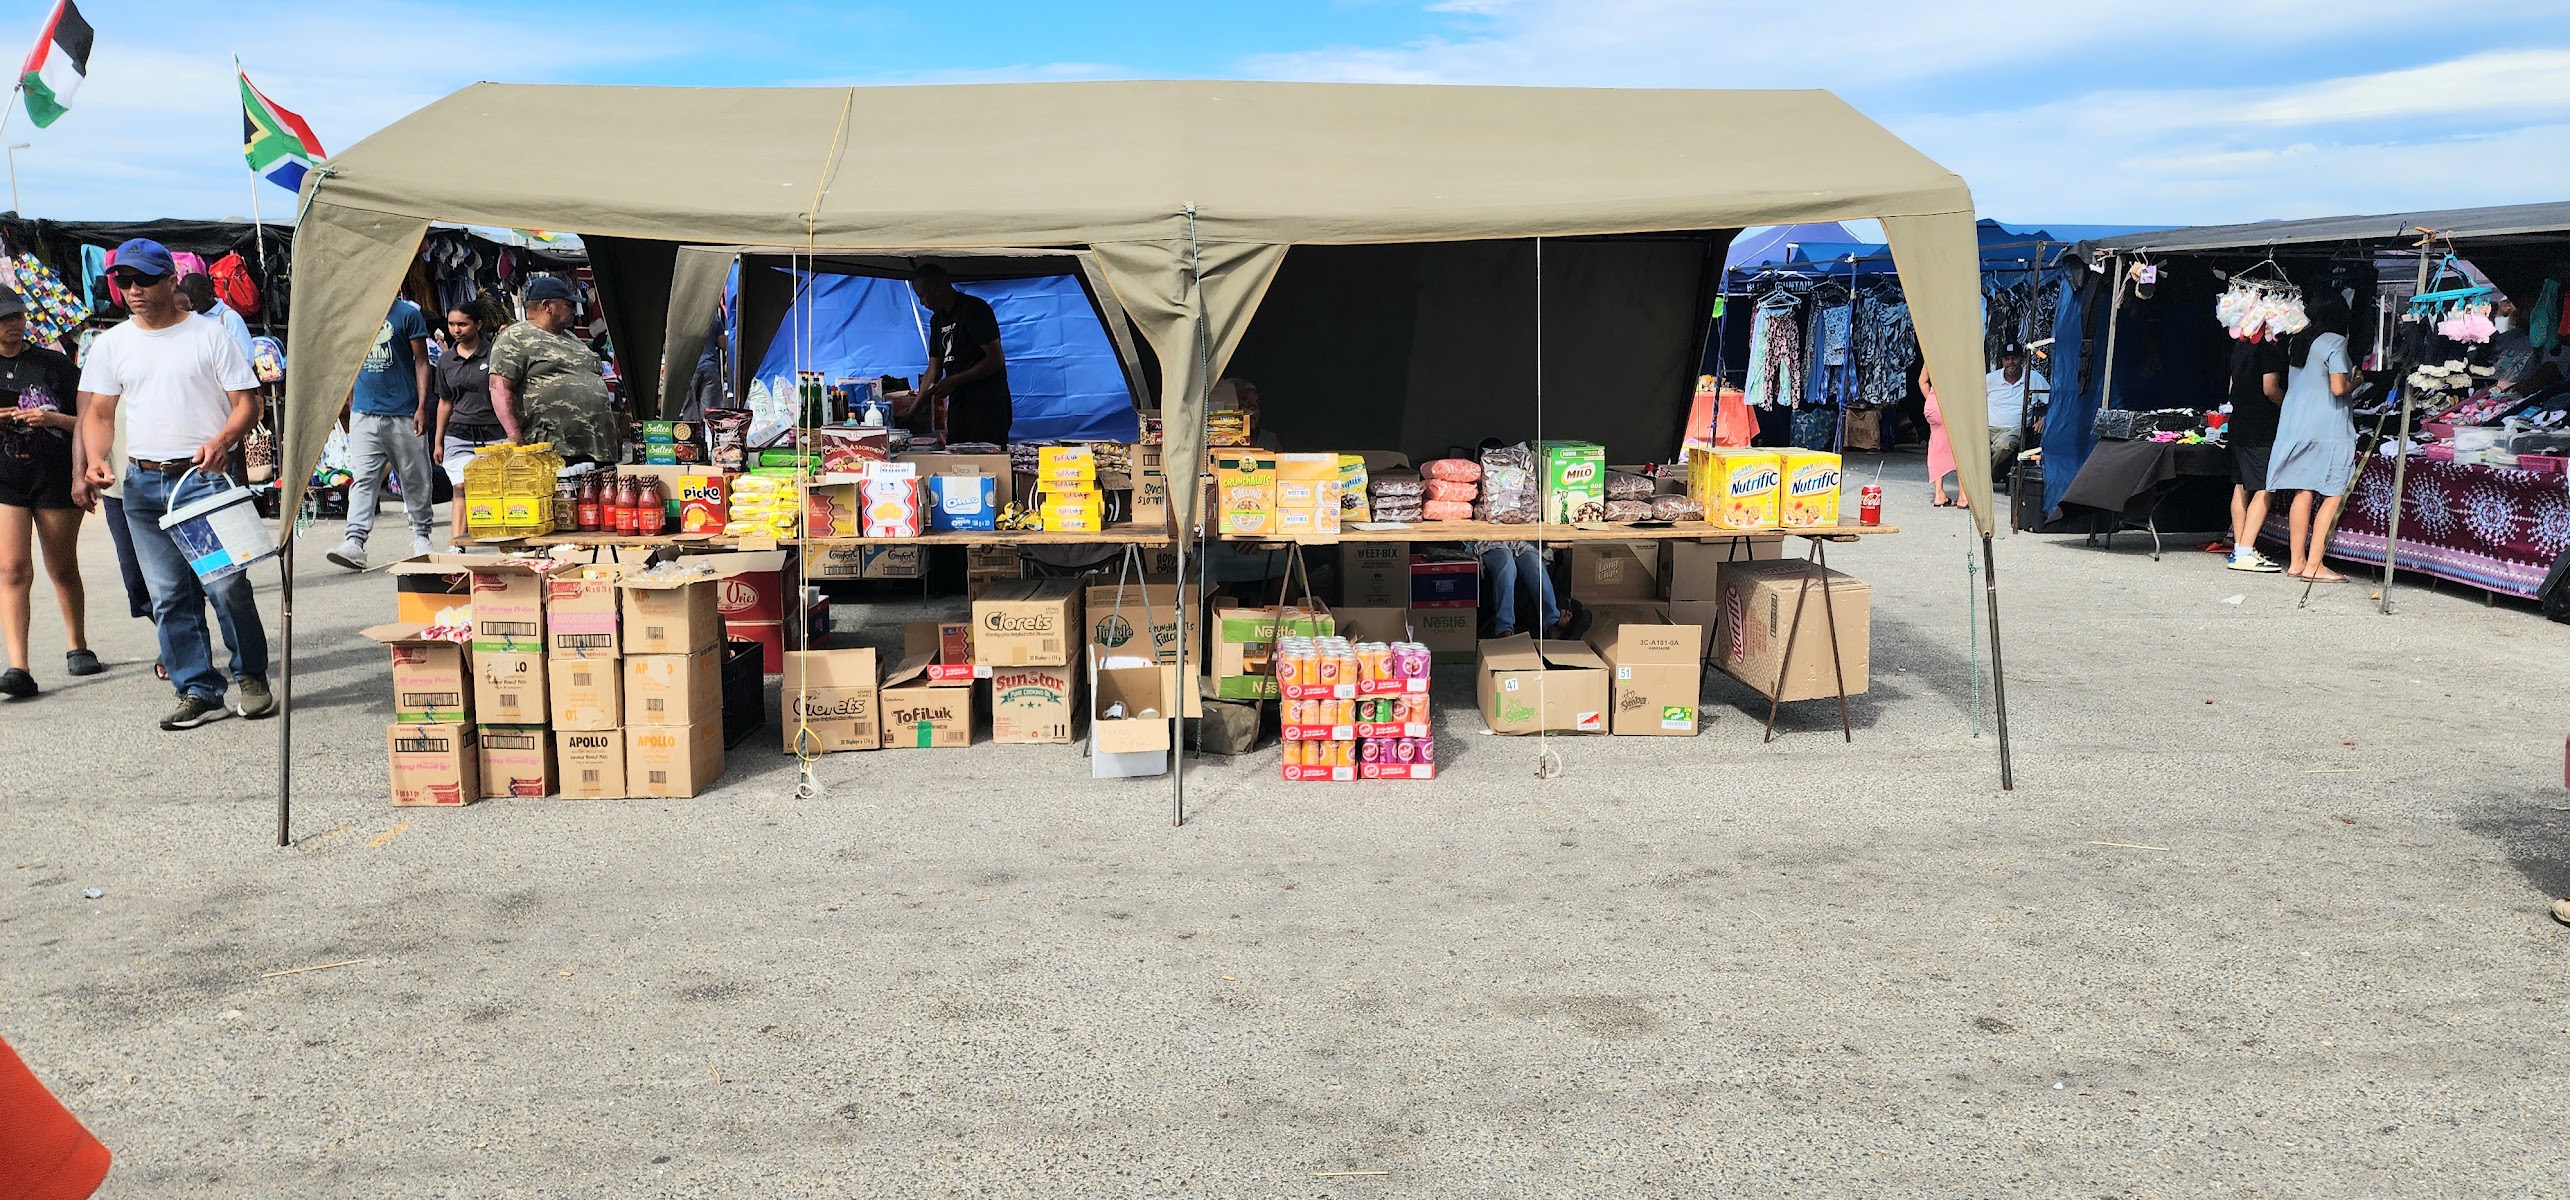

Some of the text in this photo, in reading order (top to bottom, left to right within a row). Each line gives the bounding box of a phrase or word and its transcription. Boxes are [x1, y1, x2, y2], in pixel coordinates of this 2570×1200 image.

[1567, 469, 1592, 479] MILO
[1341, 475, 1364, 489] squik
[684, 486, 719, 500] Picko
[829, 550, 857, 562] Comfort
[888, 550, 915, 562] Comfort
[985, 611, 1053, 631] Clorets
[636, 663, 673, 674] APO
[1621, 668, 1630, 678] 51
[996, 671, 1064, 692] SunStar
[1252, 681, 1279, 693] Nes
[1507, 680, 1516, 690] 47
[1621, 696, 1647, 711] Simba
[892, 707, 953, 725] TofiLuk
[569, 737, 608, 748] APOLLO
[637, 735, 675, 749] APOLLO
